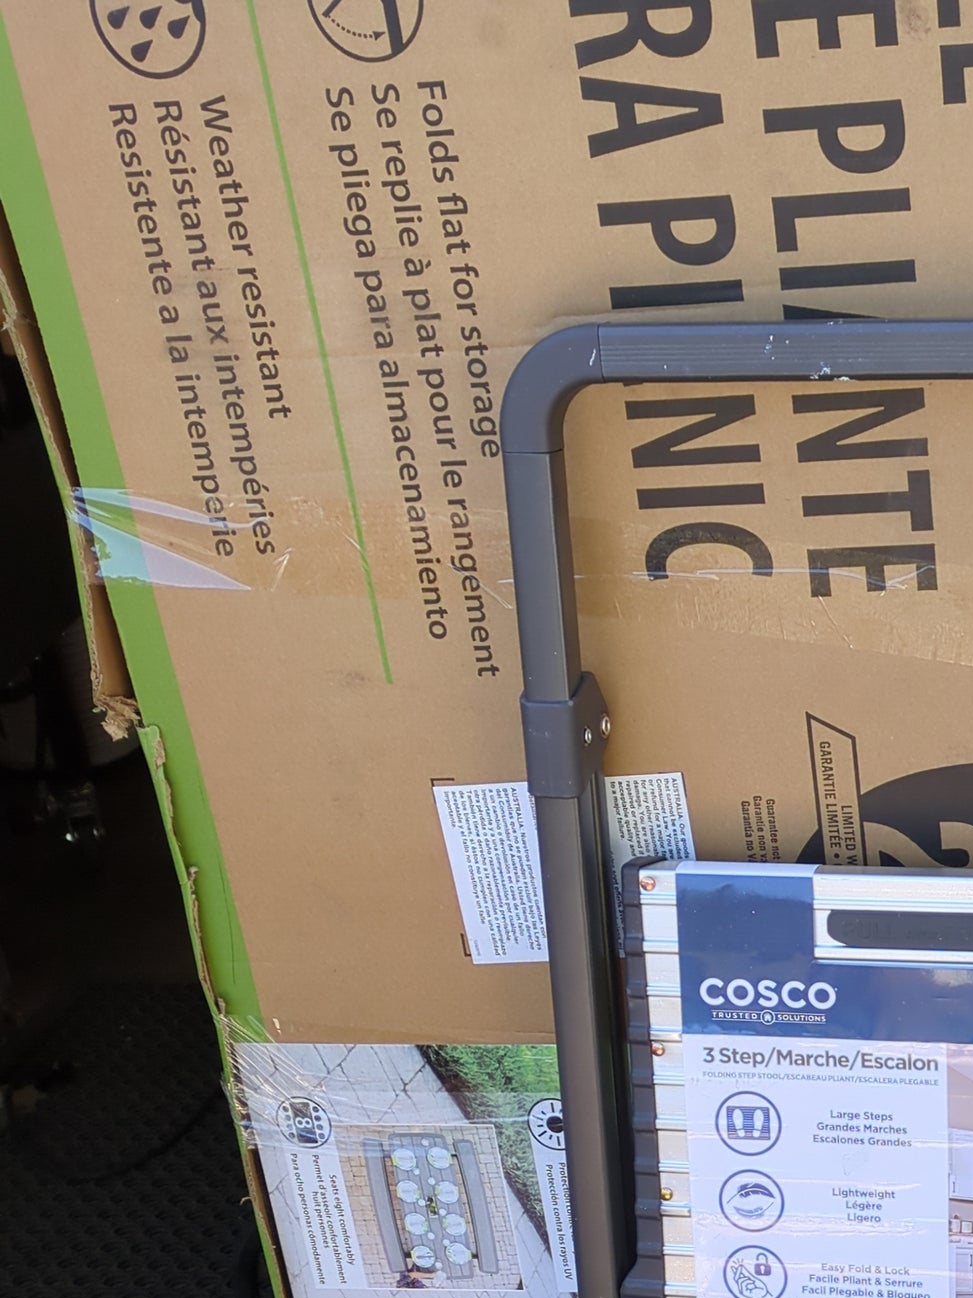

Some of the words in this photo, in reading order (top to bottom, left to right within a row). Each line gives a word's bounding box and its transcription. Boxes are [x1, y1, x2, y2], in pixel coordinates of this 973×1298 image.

[325, 87, 354, 132] Se
[371, 83, 400, 128] Se
[417, 80, 459, 183] Folds
[108, 103, 172, 295] Resistente
[328, 144, 376, 258] pliega
[381, 140, 422, 247] replie
[437, 193, 471, 254] flat
[200, 94, 253, 256] Weather
[237, 267, 292, 419] resistant
[403, 257, 431, 277] à
[354, 270, 394, 349] para
[450, 263, 479, 316] for
[153, 100, 215, 271] Résistant
[196, 281, 229, 344] aux
[213, 354, 275, 555] intempéries
[158, 304, 180, 324] a
[402, 288, 444, 358] plat
[165, 335, 192, 363] la
[762, 99, 938, 598] PLINTE
[460, 326, 500, 458] storage
[597, 194, 773, 581] PINIC
[417, 369, 456, 450] pour
[175, 374, 236, 557] intemperie
[440, 459, 467, 488] le
[378, 359, 447, 640] almacenamiento
[447, 498, 500, 677] rangement
[818, 741, 837, 800] GARANTIE
[741, 801, 753, 837] Garantía
[753, 795, 765, 832] Garantie
[766, 799, 778, 842] Guarantee
[825, 803, 842, 849] LIMITÉE
[841, 805, 857, 851] LIMITED
[746, 840, 754, 850] no
[757, 835, 766, 850] non
[700, 978, 837, 1010] COSCO
[712, 1011, 758, 1020] TRUSTED
[777, 1014, 826, 1022] SOLUTIONS
[702, 1071, 737, 1079] FOLDING
[899, 1078, 939, 1086] PLEGABLE
[703, 1047, 715, 1064] 3
[719, 1047, 939, 1071] Step/Marche/Escalon
[816, 1122, 861, 1133] Grandes
[863, 1123, 907, 1135] Marches
[830, 1110, 860, 1121] Large
[863, 1111, 893, 1122] Steps
[812, 1134, 865, 1145] Escalones
[868, 1136, 912, 1148] Grandes
[290, 1153, 299, 1171] Para
[295, 1172, 303, 1192] ocho
[329, 1174, 338, 1195] Seats
[832, 1187, 896, 1199] Lightweight
[298, 1193, 312, 1228] personas
[312, 1154, 323, 1183] Permet
[327, 1220, 347, 1284] confortablement
[332, 1197, 344, 1216] eight
[546, 1164, 558, 1205] Protección
[553, 1207, 562, 1232] contra
[559, 1247, 568, 1266] rayos
[564, 1269, 572, 1279] UV
[845, 1200, 882, 1212] Légère
[847, 1213, 881, 1223] Ligero
[314, 1208, 329, 1248] personnes
[339, 1218, 355, 1265] comfortably
[809, 1274, 840, 1284] Facile
[842, 1275, 872, 1285] Pliant
[874, 1277, 882, 1286] &
[884, 1278, 923, 1288] Serrure
[821, 1263, 845, 1274] Easy
[848, 1264, 872, 1274] Fold
[874, 1265, 882, 1274] &
[885, 1266, 910, 1276] Lock
[802, 1286, 826, 1295] Facil
[829, 1287, 874, 1298] Plegable
[876, 1289, 884, 1298] &
